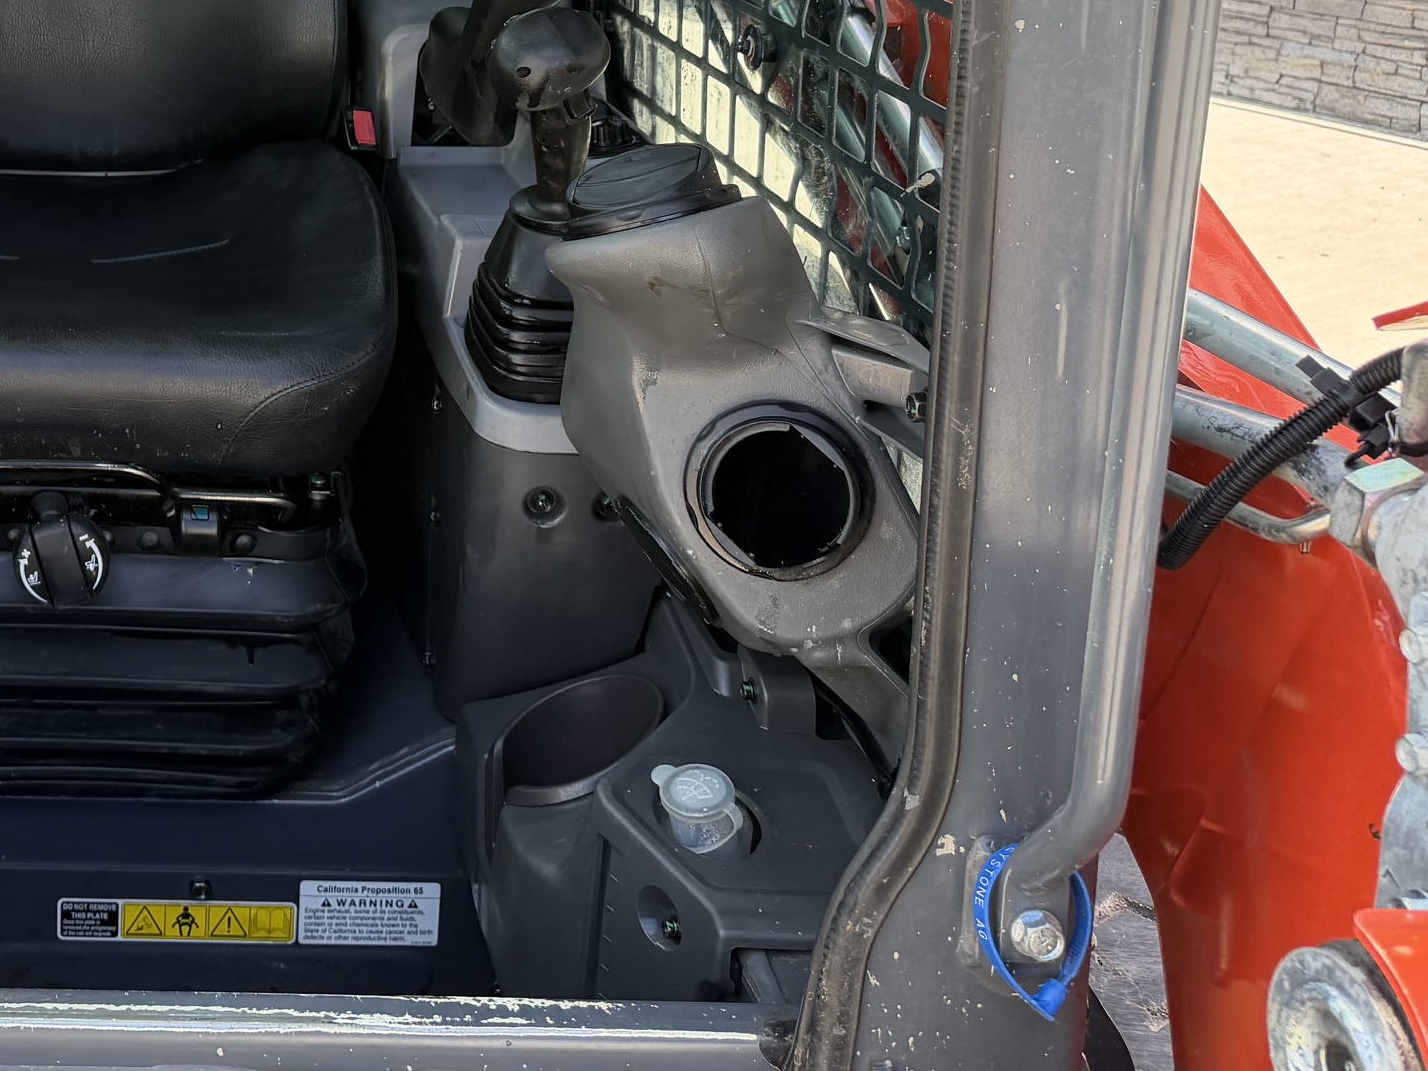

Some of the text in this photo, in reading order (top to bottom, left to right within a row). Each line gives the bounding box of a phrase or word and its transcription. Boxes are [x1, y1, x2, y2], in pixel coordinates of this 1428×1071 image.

[317, 885, 358, 893] California
[362, 886, 410, 895] Proposition
[337, 899, 404, 908] WARNING
